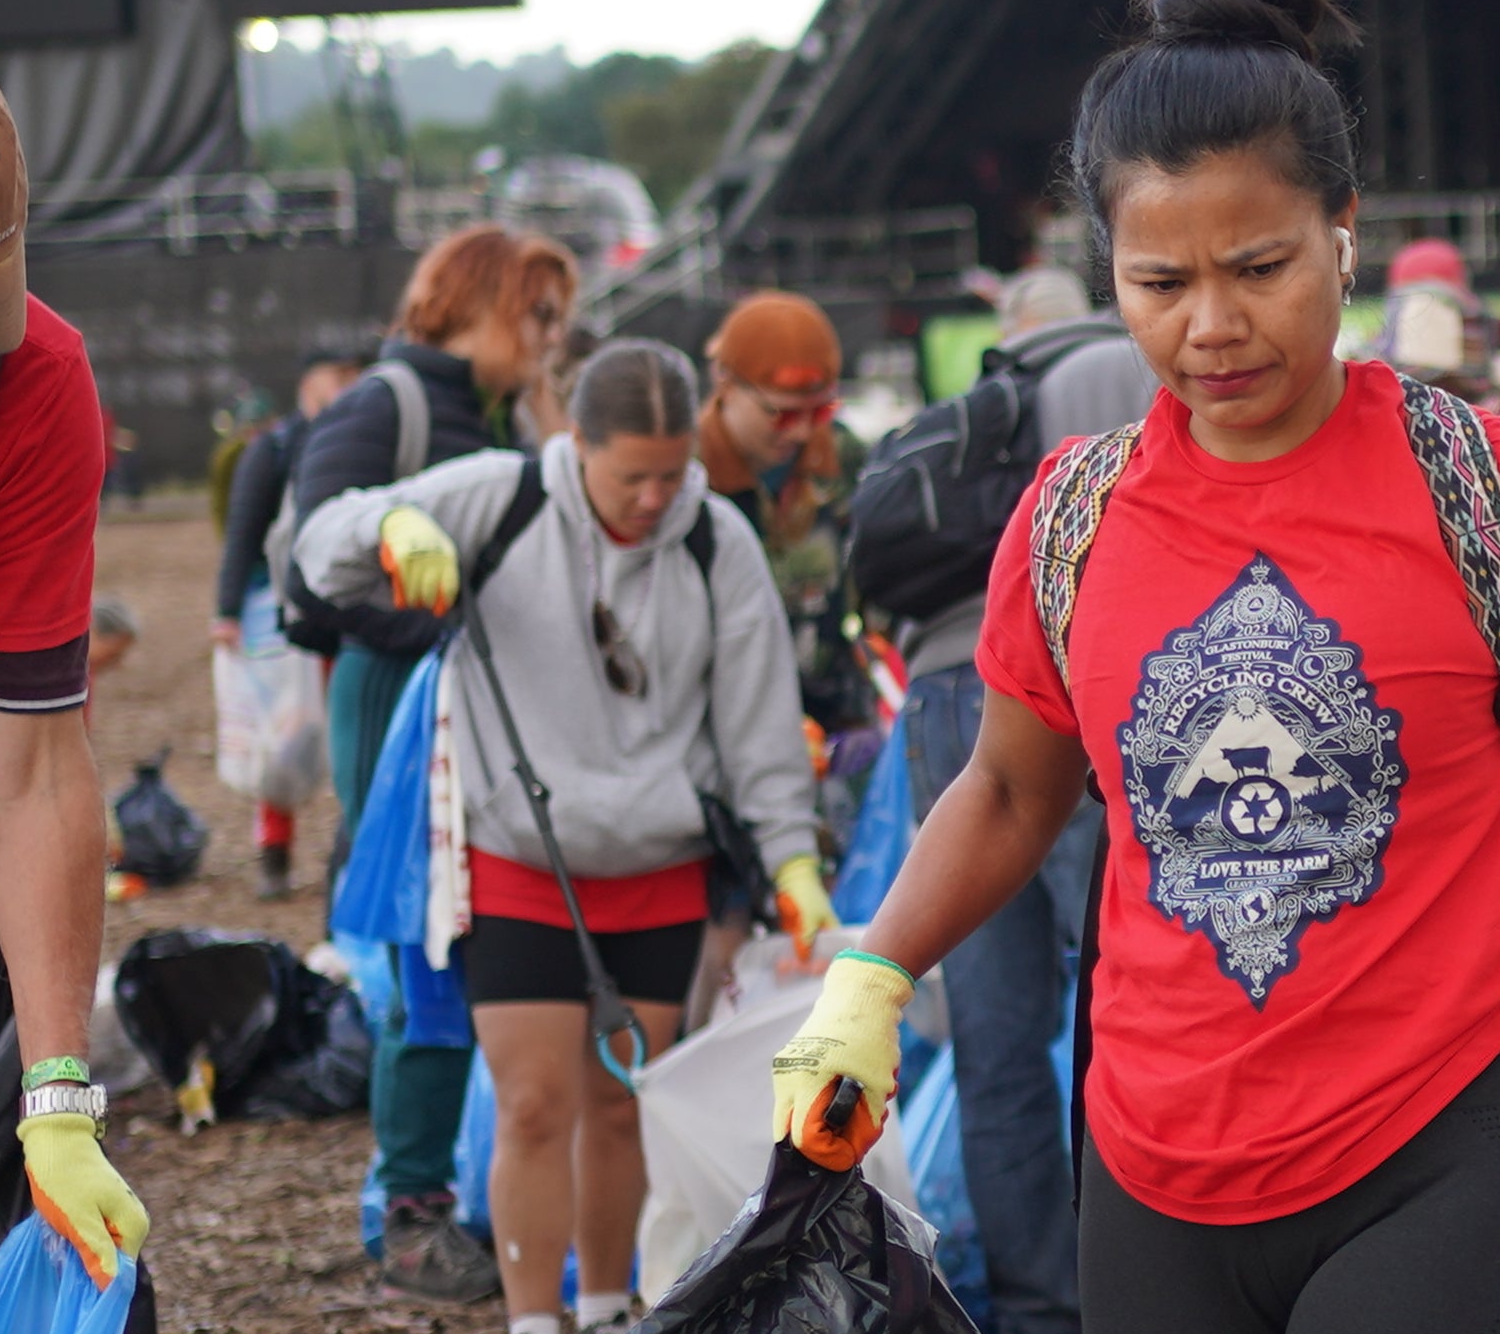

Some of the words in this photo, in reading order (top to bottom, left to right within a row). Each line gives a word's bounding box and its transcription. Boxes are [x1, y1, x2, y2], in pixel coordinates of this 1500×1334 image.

[1236, 624, 1269, 637] 2023
[1205, 640, 1293, 656] GLASTONBURY
[1221, 651, 1273, 663] FESTIVAL
[1164, 671, 1275, 735] RECYCLING
[1278, 677, 1337, 725] CREW
[1201, 861, 1241, 879] LOVE
[1244, 859, 1281, 876] THE
[1283, 854, 1330, 873] FARM
[1228, 880, 1254, 890] LEAVE
